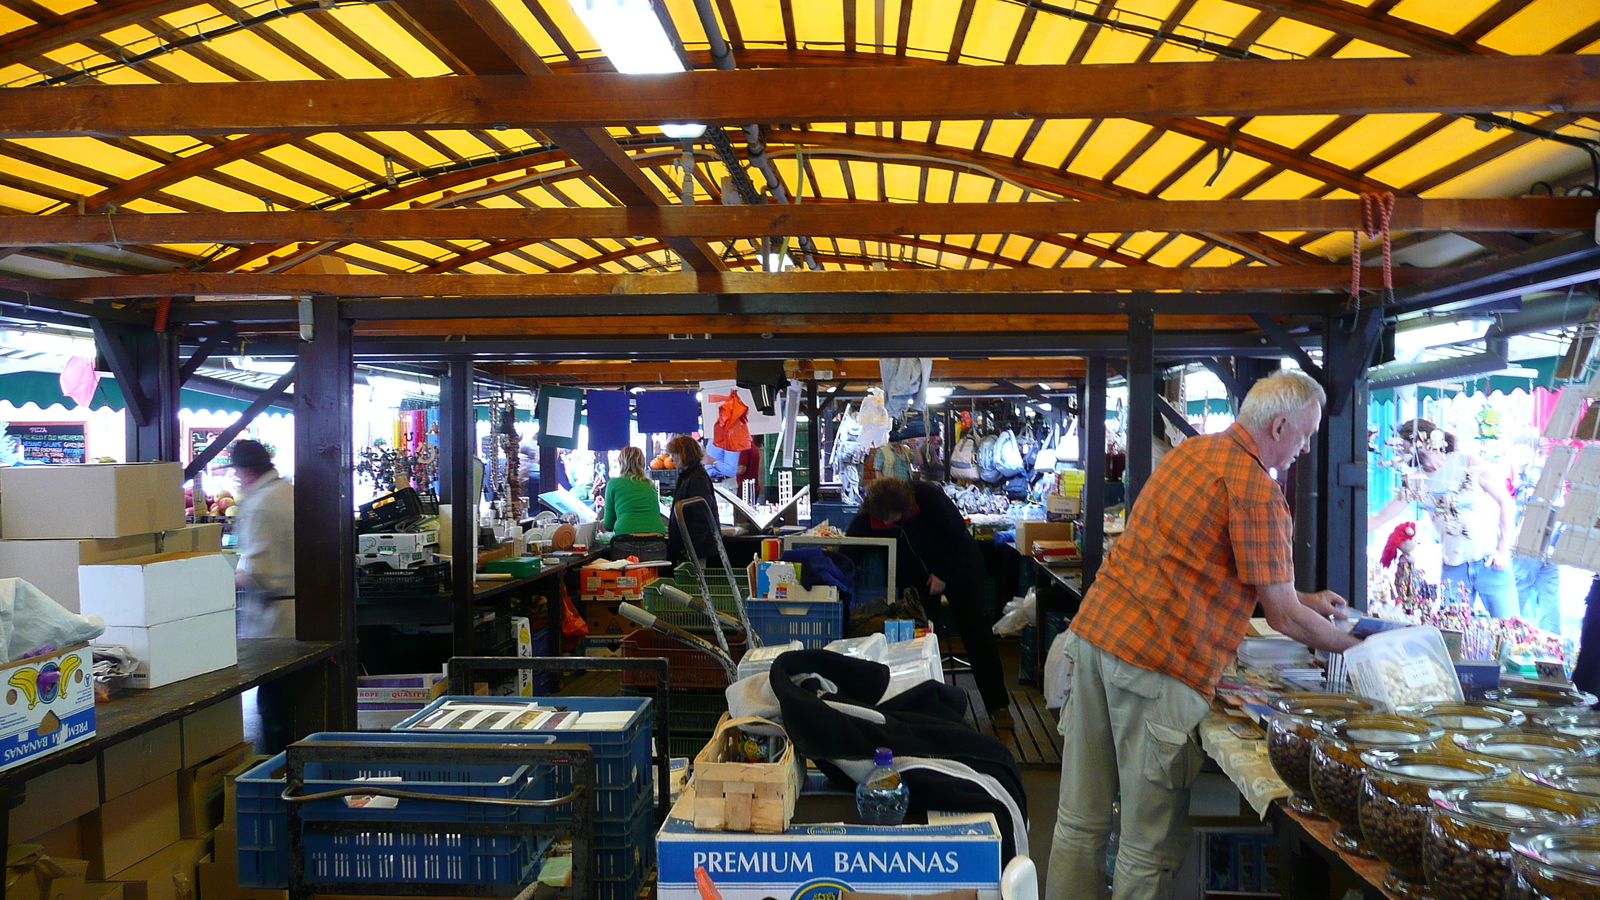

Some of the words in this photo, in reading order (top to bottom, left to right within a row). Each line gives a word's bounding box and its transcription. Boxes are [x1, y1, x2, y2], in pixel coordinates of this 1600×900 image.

[52, 721, 89, 744] PREMM
[4, 736, 48, 761] BANANAS
[693, 851, 813, 873] PREMIUM
[834, 850, 959, 874] BANANAS
